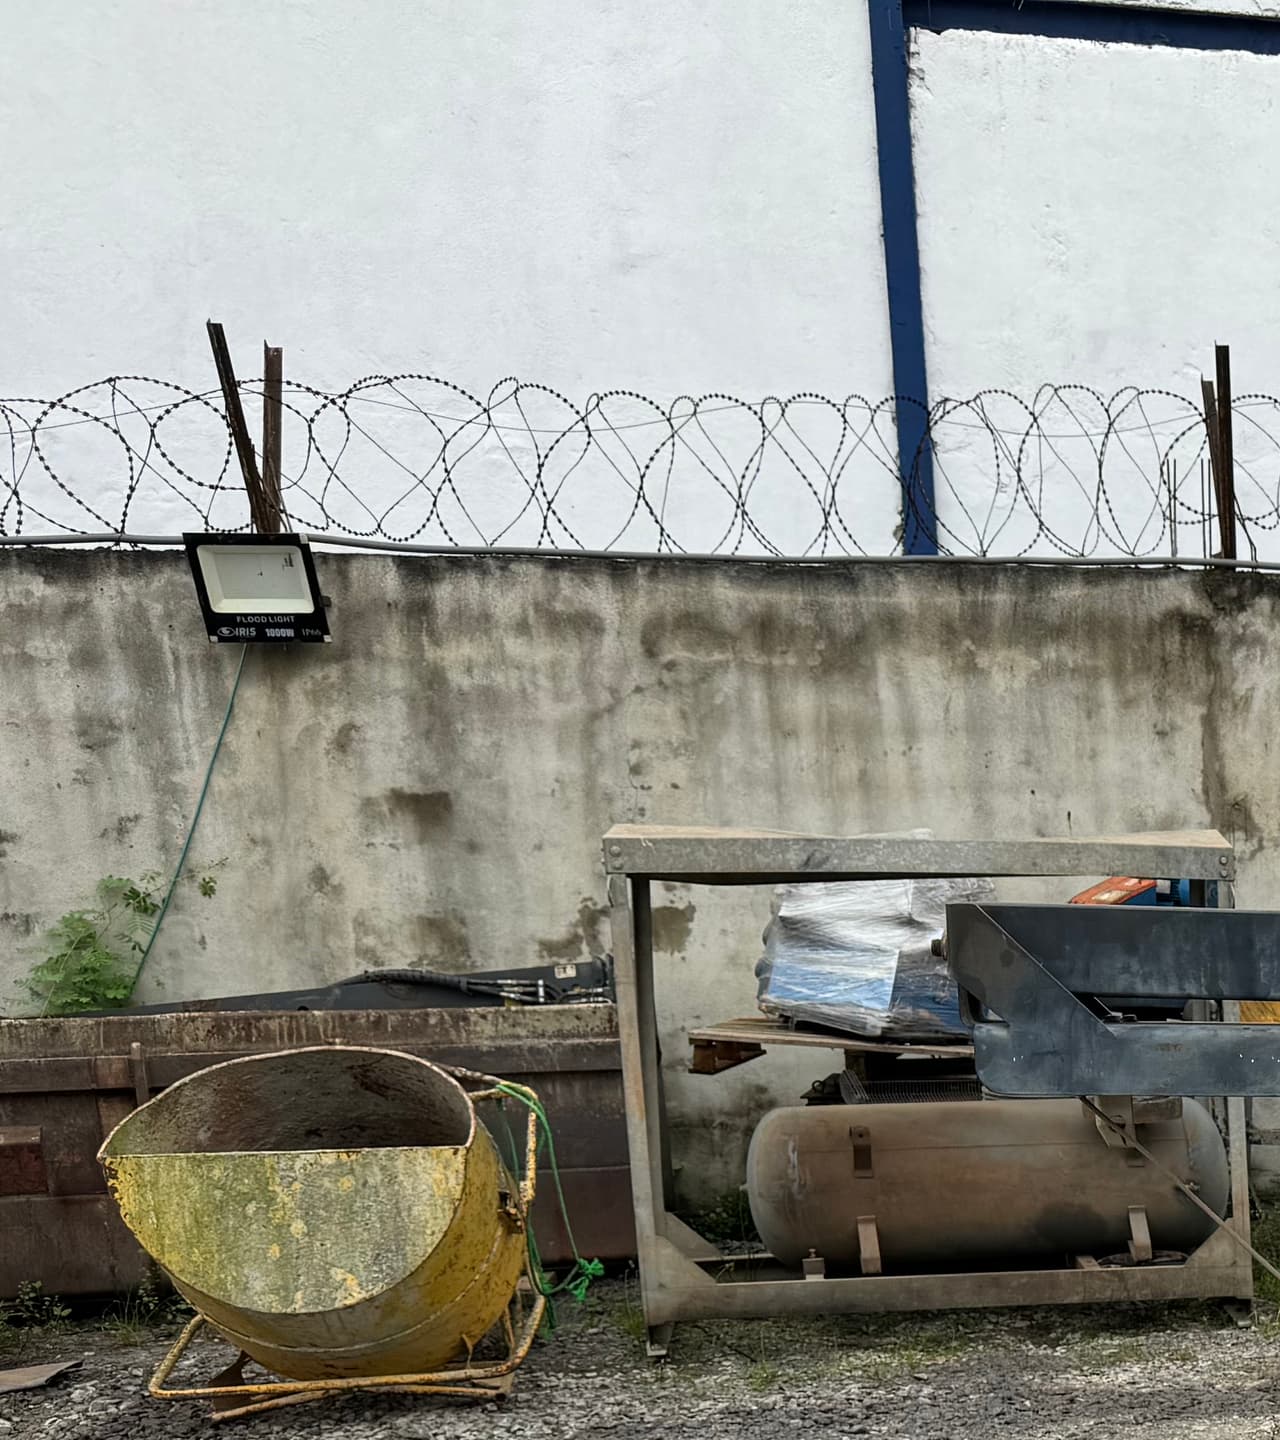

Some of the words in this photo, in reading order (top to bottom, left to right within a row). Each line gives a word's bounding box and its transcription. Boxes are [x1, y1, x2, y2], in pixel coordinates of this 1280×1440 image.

[236, 615, 267, 623] FLOOD
[269, 615, 295, 623] LIGHT
[235, 627, 257, 636] IRIS
